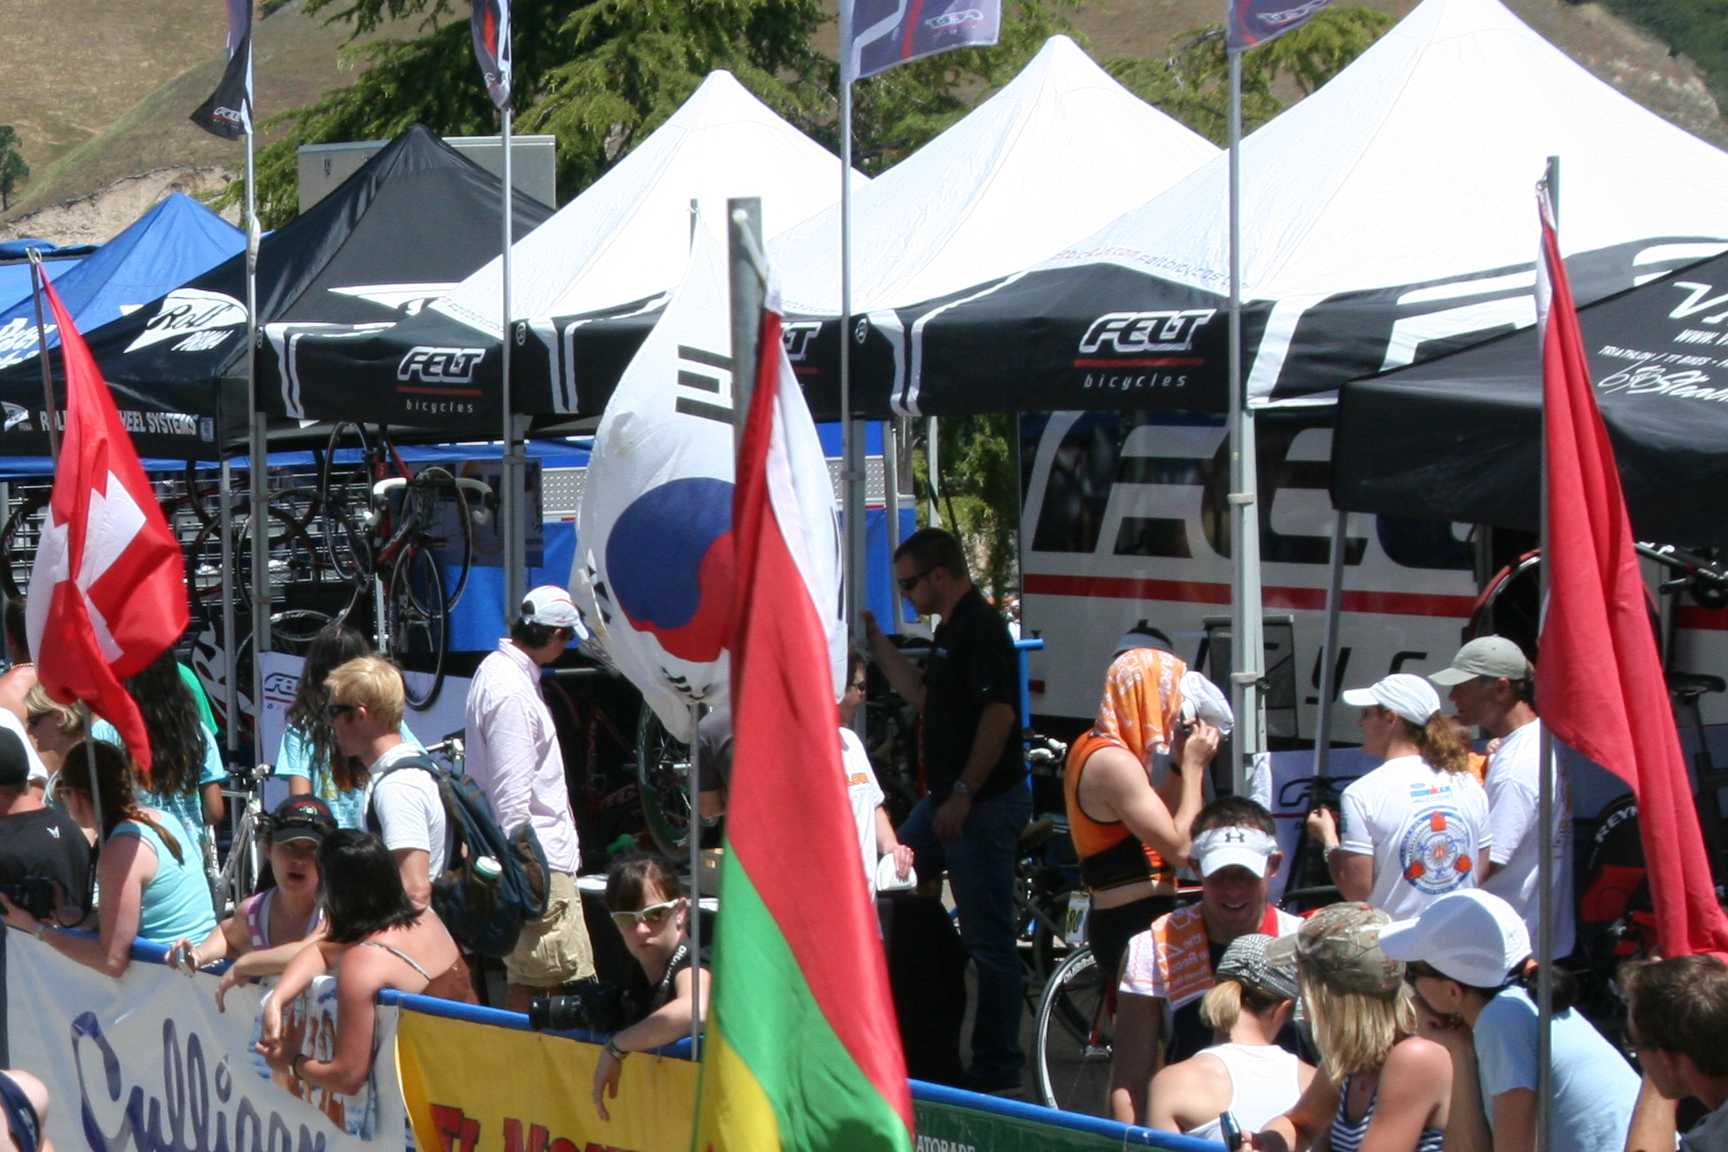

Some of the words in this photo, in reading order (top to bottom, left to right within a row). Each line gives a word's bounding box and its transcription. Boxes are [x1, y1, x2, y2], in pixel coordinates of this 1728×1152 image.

[1079, 308, 1218, 354] FELT
[397, 346, 486, 383] FELT
[1083, 373, 1187, 391] bicycles
[406, 399, 474, 414] bicycles
[147, 411, 198, 437] SYSTEMS
[1594, 805, 1638, 844] REYN
